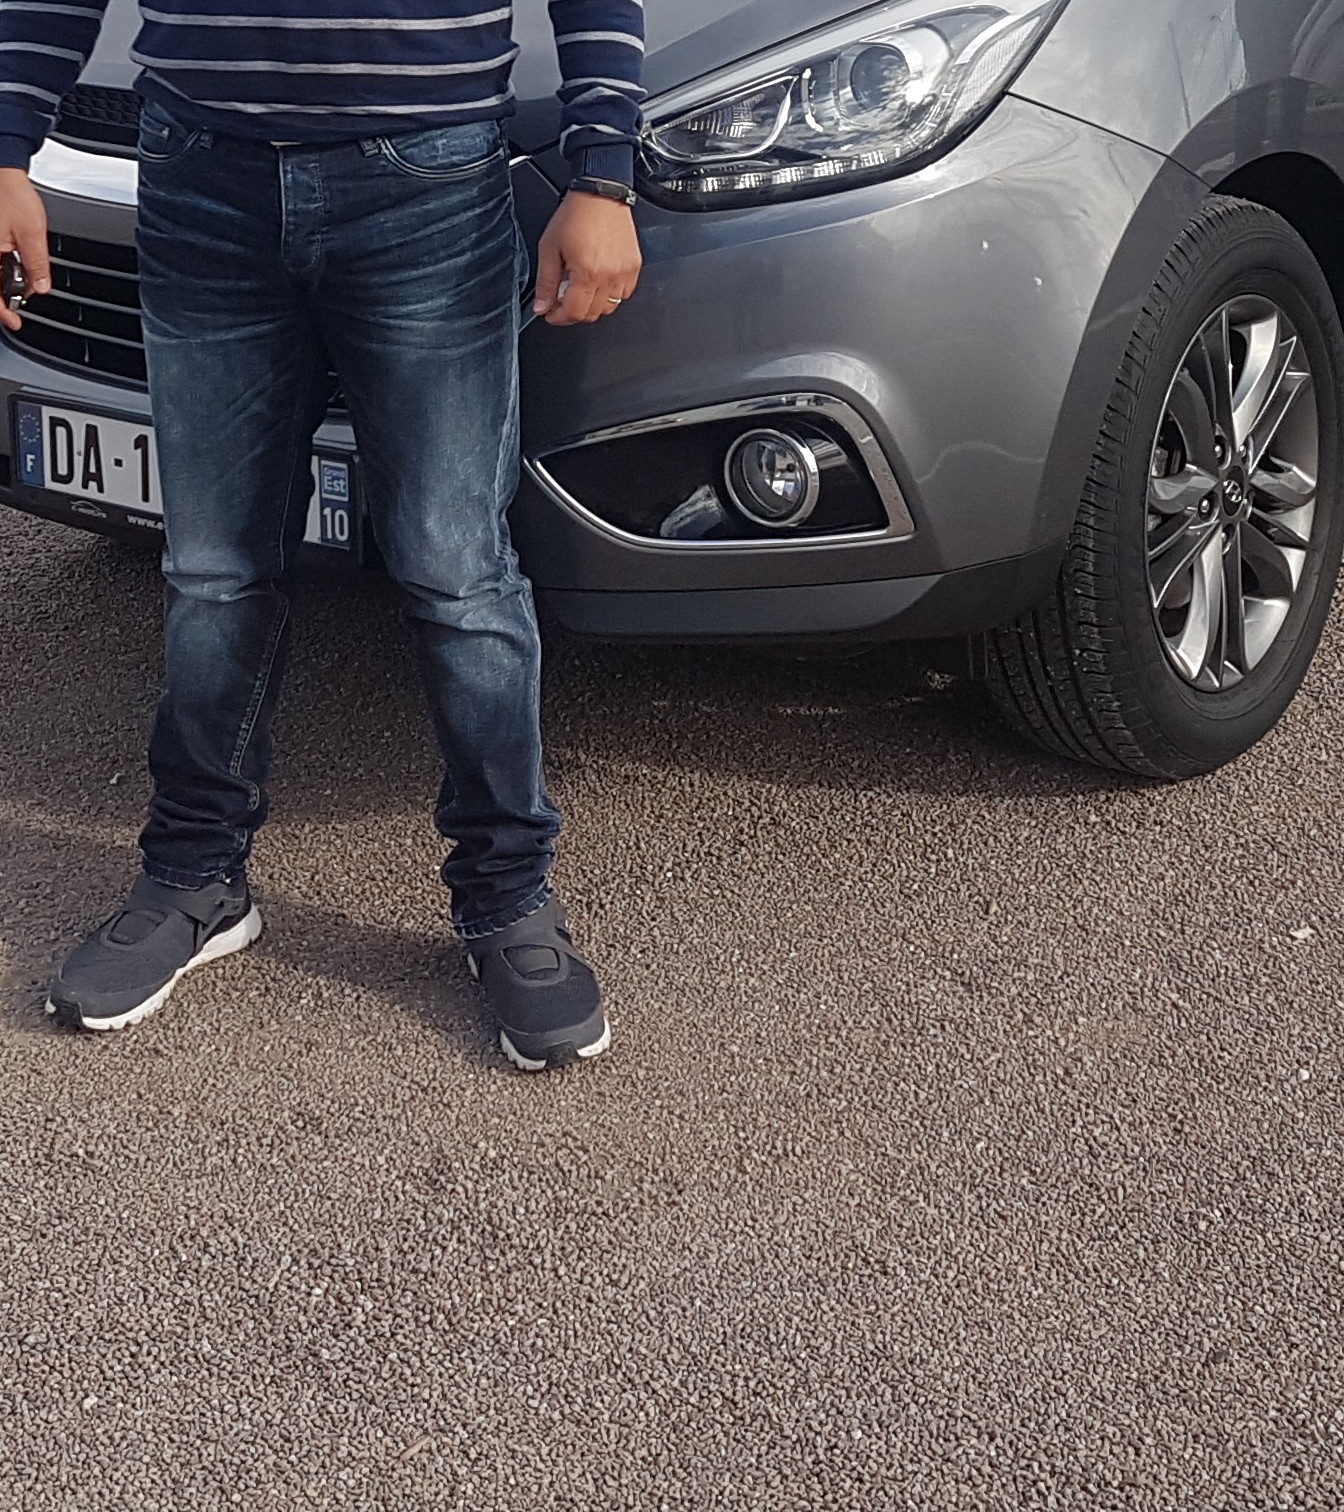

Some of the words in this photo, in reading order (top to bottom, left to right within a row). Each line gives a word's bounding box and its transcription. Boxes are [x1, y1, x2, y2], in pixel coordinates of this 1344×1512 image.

[26, 454, 36, 473] F
[48, 414, 151, 504] DA-1
[323, 476, 347, 494] Est
[126, 514, 164, 530] www.e
[322, 506, 350, 542] 10
